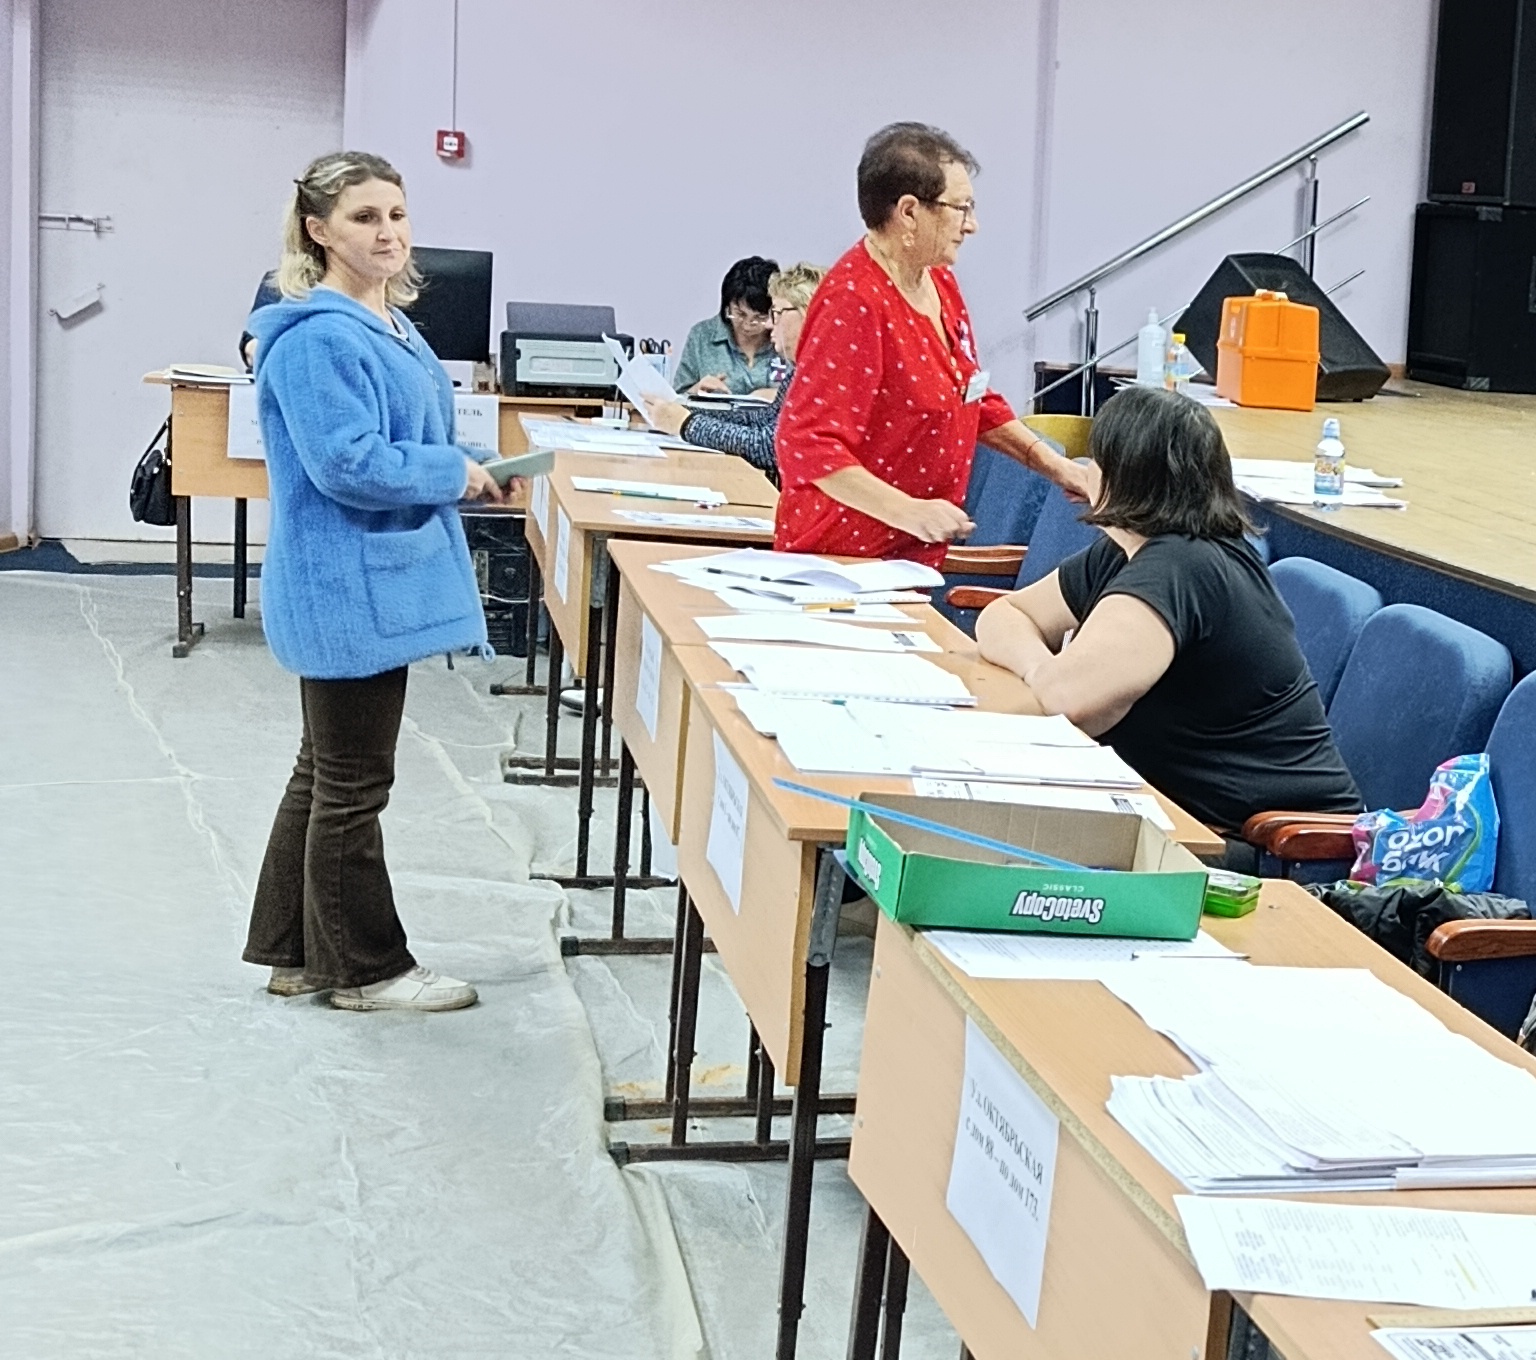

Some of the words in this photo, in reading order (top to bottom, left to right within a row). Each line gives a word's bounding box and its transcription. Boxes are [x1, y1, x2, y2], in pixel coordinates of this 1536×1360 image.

[1387, 825, 1466, 852] ozon
[1042, 883, 1085, 893] CLASSIC
[1010, 890, 1105, 923] SvetoCopy
[983, 1097, 1044, 1185] ОКТЯБРЬСКАЯ
